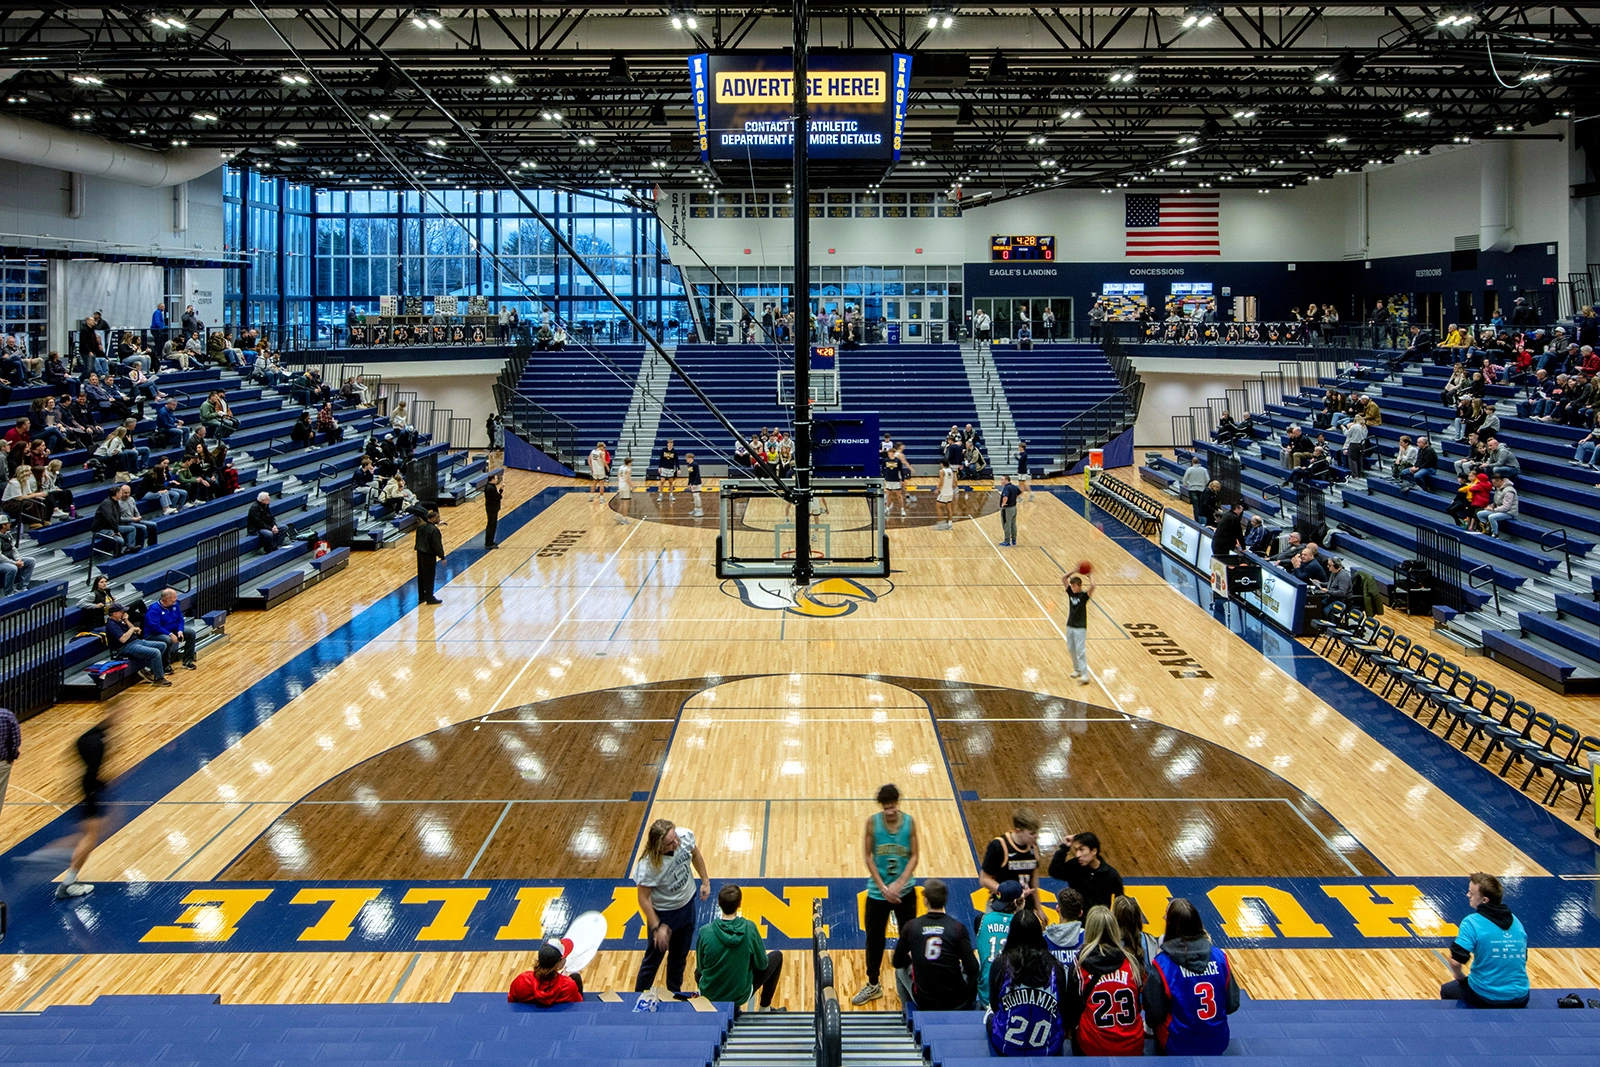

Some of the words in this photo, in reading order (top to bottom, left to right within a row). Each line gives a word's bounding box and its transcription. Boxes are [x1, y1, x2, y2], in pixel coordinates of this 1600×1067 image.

[722, 77, 823, 97] ADVERTSE
[828, 77, 880, 97] HERE!
[693, 58, 708, 151] EAGLES
[893, 57, 907, 151] EAGLES
[744, 121, 788, 132] CONTACT
[812, 121, 858, 132] ATHLETIC
[721, 134, 787, 145] DEPARTMENT
[810, 134, 839, 145] MORE
[840, 134, 882, 145] DETAILS
[1016, 236, 1036, 245] 4:28
[1002, 250, 1009, 260] 0
[1045, 250, 1052, 260] 0
[1129, 268, 1185, 276] CONCESSIONS
[816, 347, 834, 357] 4:28
[1123, 622, 1213, 679] EAGLES
[924, 936, 943, 960] 6
[1179, 961, 1219, 978] WAACE
[1091, 987, 1137, 1029] 23
[1194, 982, 1217, 1021] 3
[1004, 1015, 1052, 1047] 20
